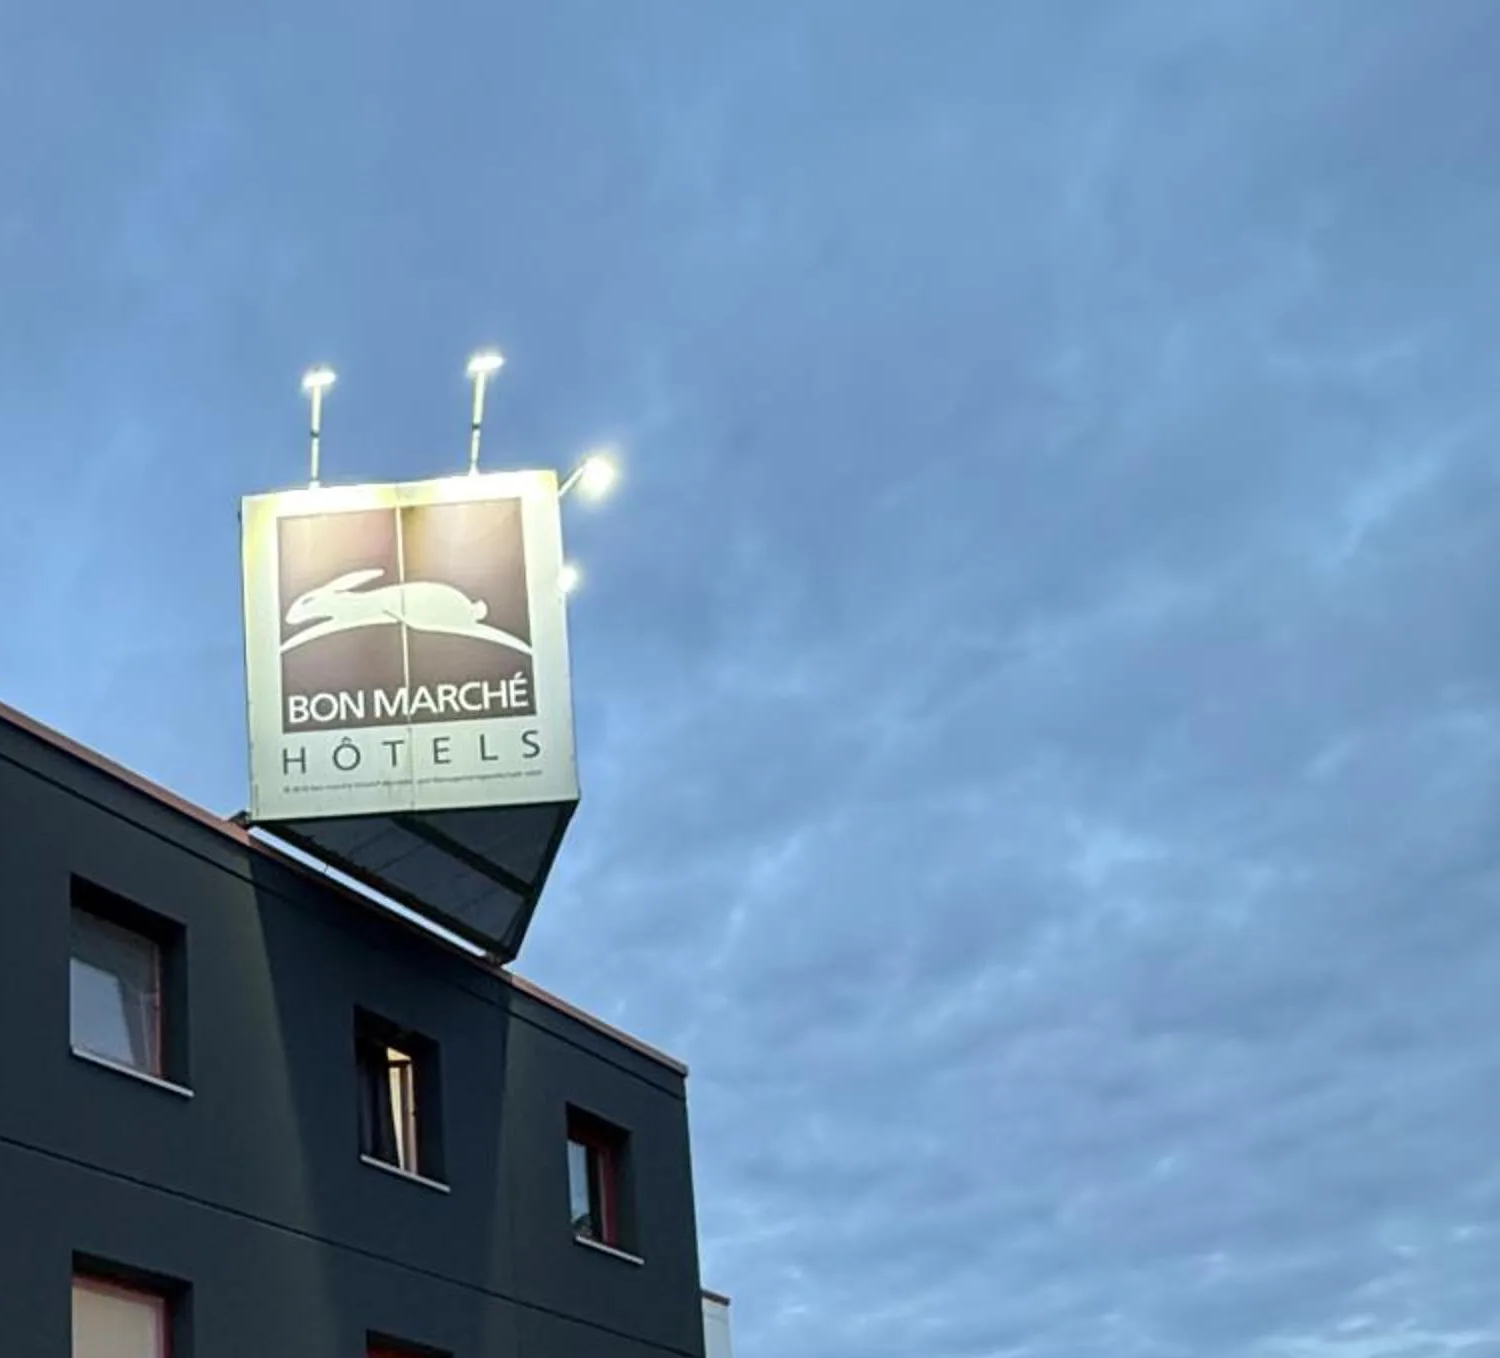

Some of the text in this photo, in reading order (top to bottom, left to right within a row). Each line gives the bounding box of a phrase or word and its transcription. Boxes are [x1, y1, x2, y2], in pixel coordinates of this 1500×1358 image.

[287, 671, 530, 724] BON MARCHÉ
[282, 729, 542, 776] HÔTELS
